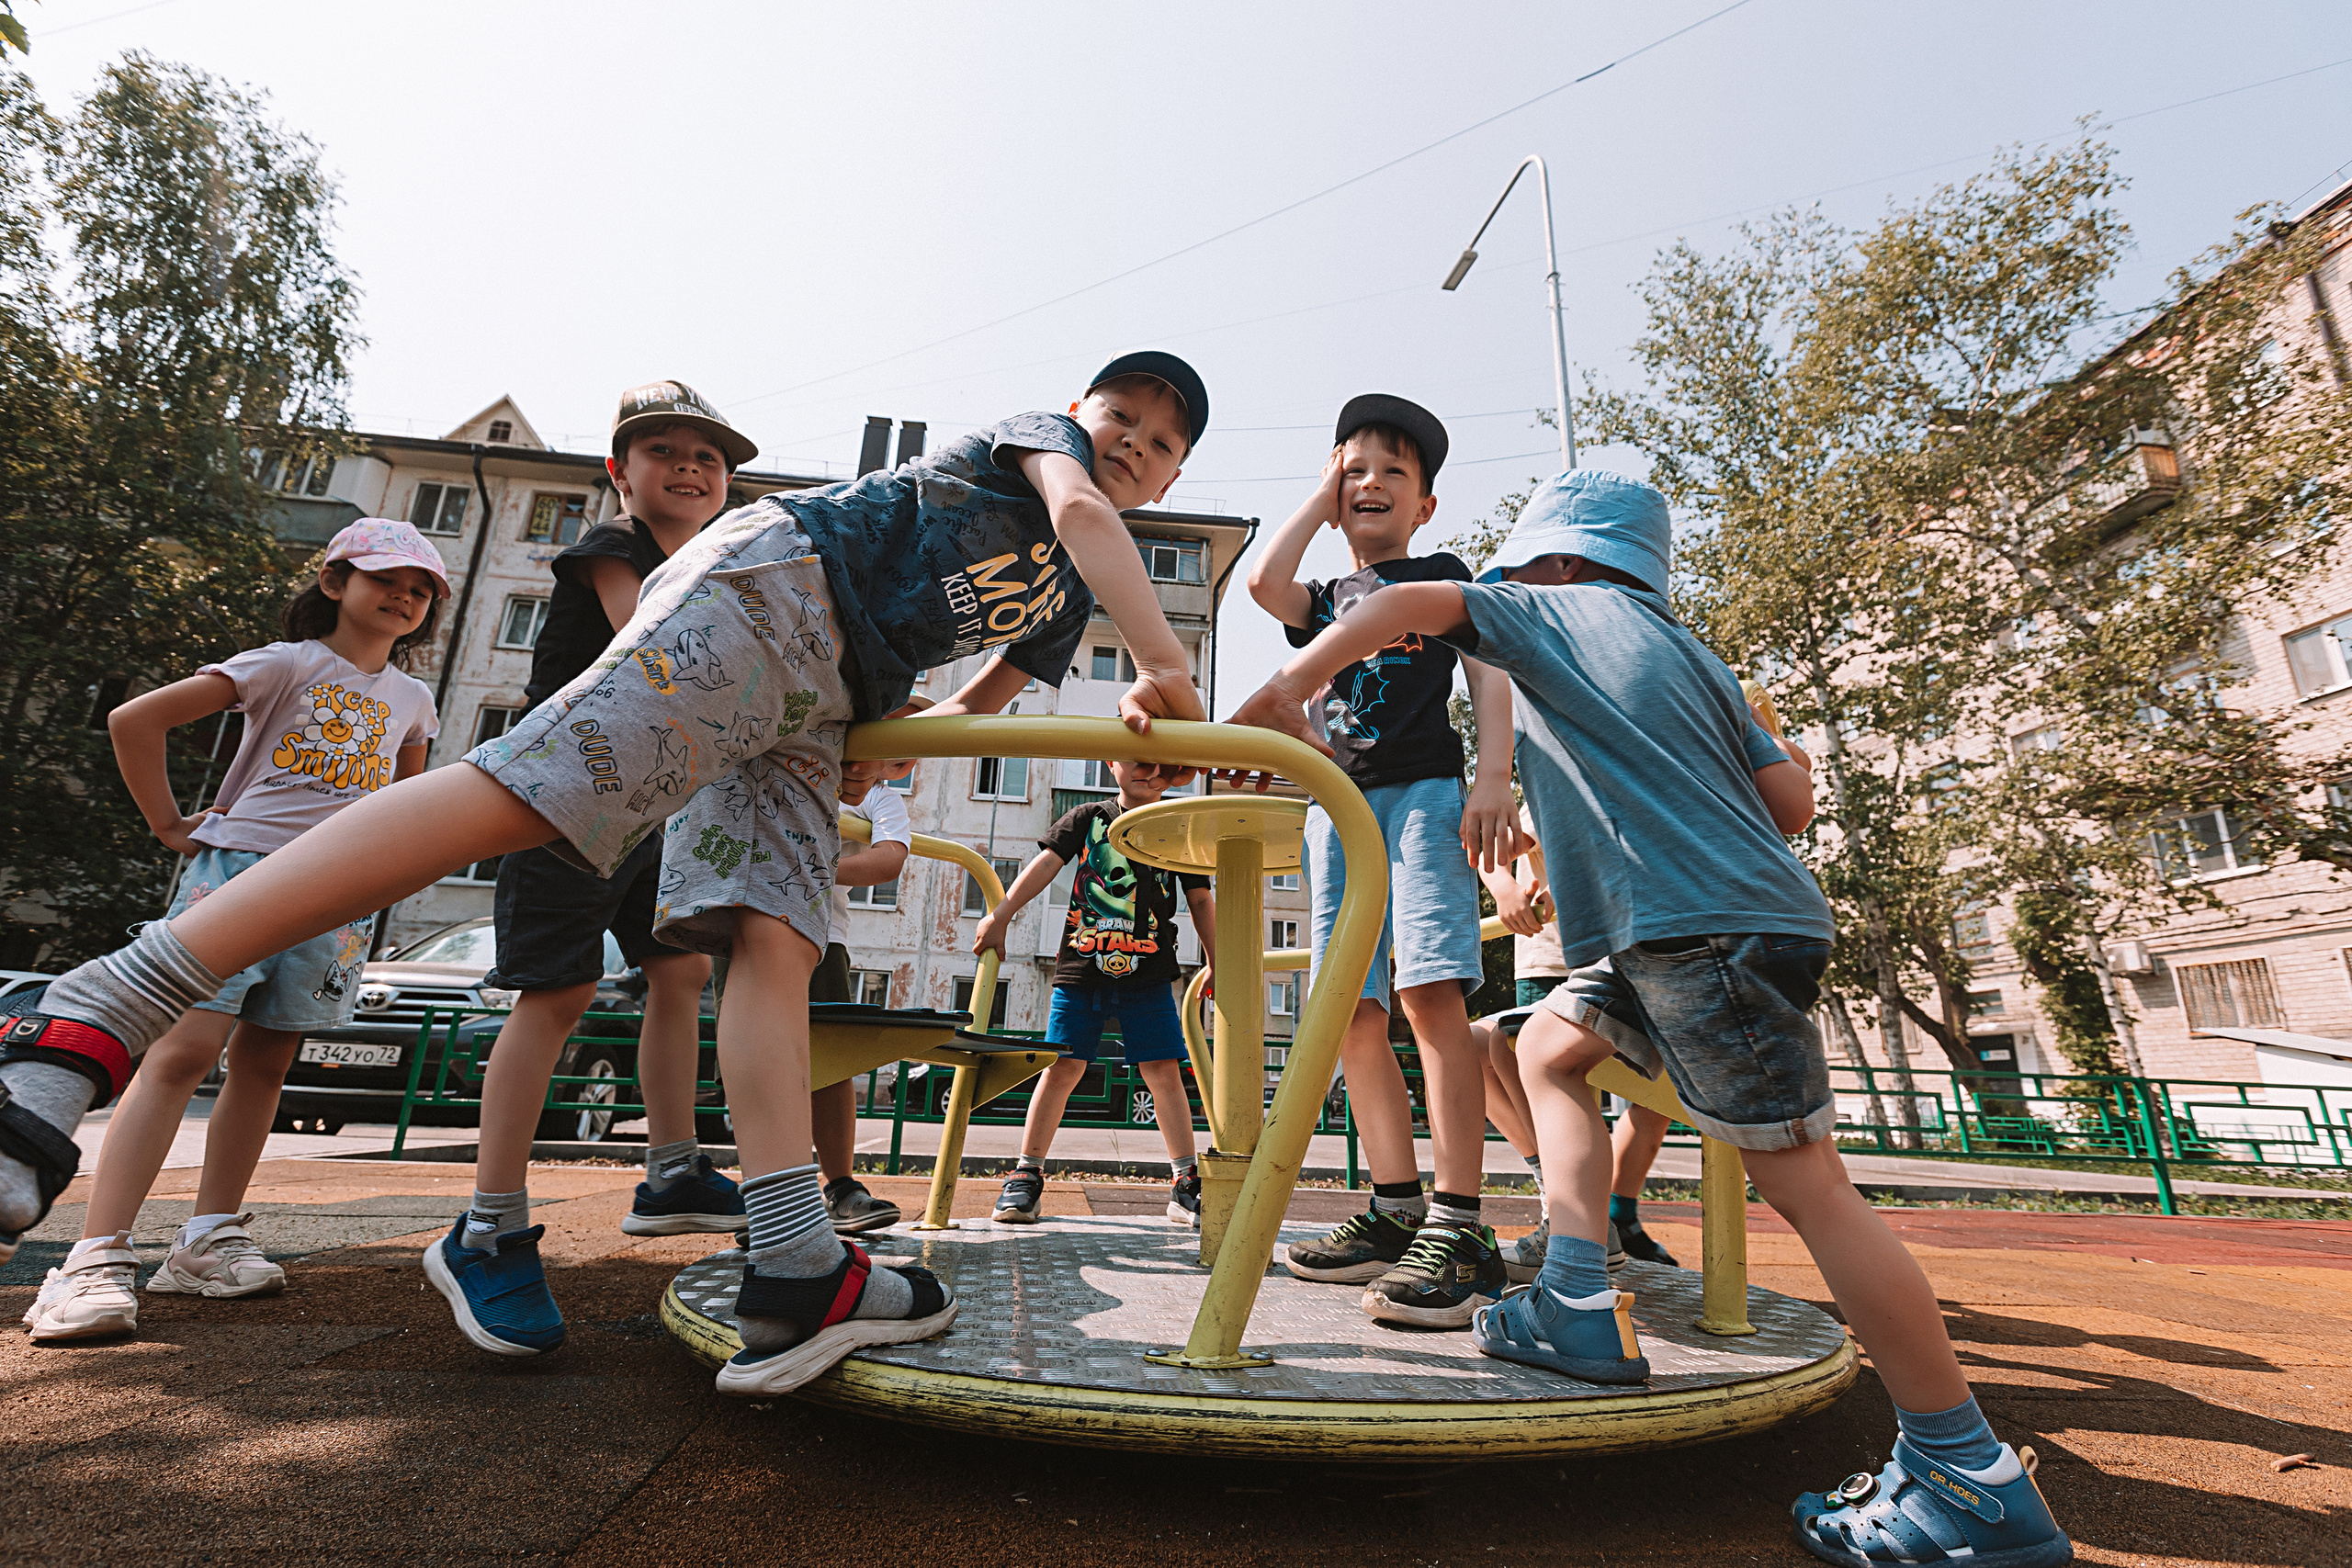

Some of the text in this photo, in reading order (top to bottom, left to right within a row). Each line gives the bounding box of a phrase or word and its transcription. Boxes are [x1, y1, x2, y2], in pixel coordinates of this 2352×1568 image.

[634, 386, 730, 426] NEW YO
[940, 501, 979, 526] Ocean
[942, 516, 988, 547] Pacific
[729, 574, 775, 641] DUDE
[940, 571, 978, 615] KEEP
[966, 552, 1030, 649] MOR
[957, 617, 982, 635] IT
[637, 648, 671, 691] Shark
[782, 642, 808, 674] HEY
[784, 689, 819, 708] WATCH
[273, 732, 392, 792] Smiling
[570, 718, 623, 795] DUDE
[625, 788, 655, 817] HEY
[692, 824, 724, 862] WAVES
[705, 834, 737, 866] SOME
[714, 840, 751, 880] WATCH
[1077, 927, 1159, 954] STARS
[1096, 918, 1136, 933] BRAW
[379, 1046, 396, 1059] 72
